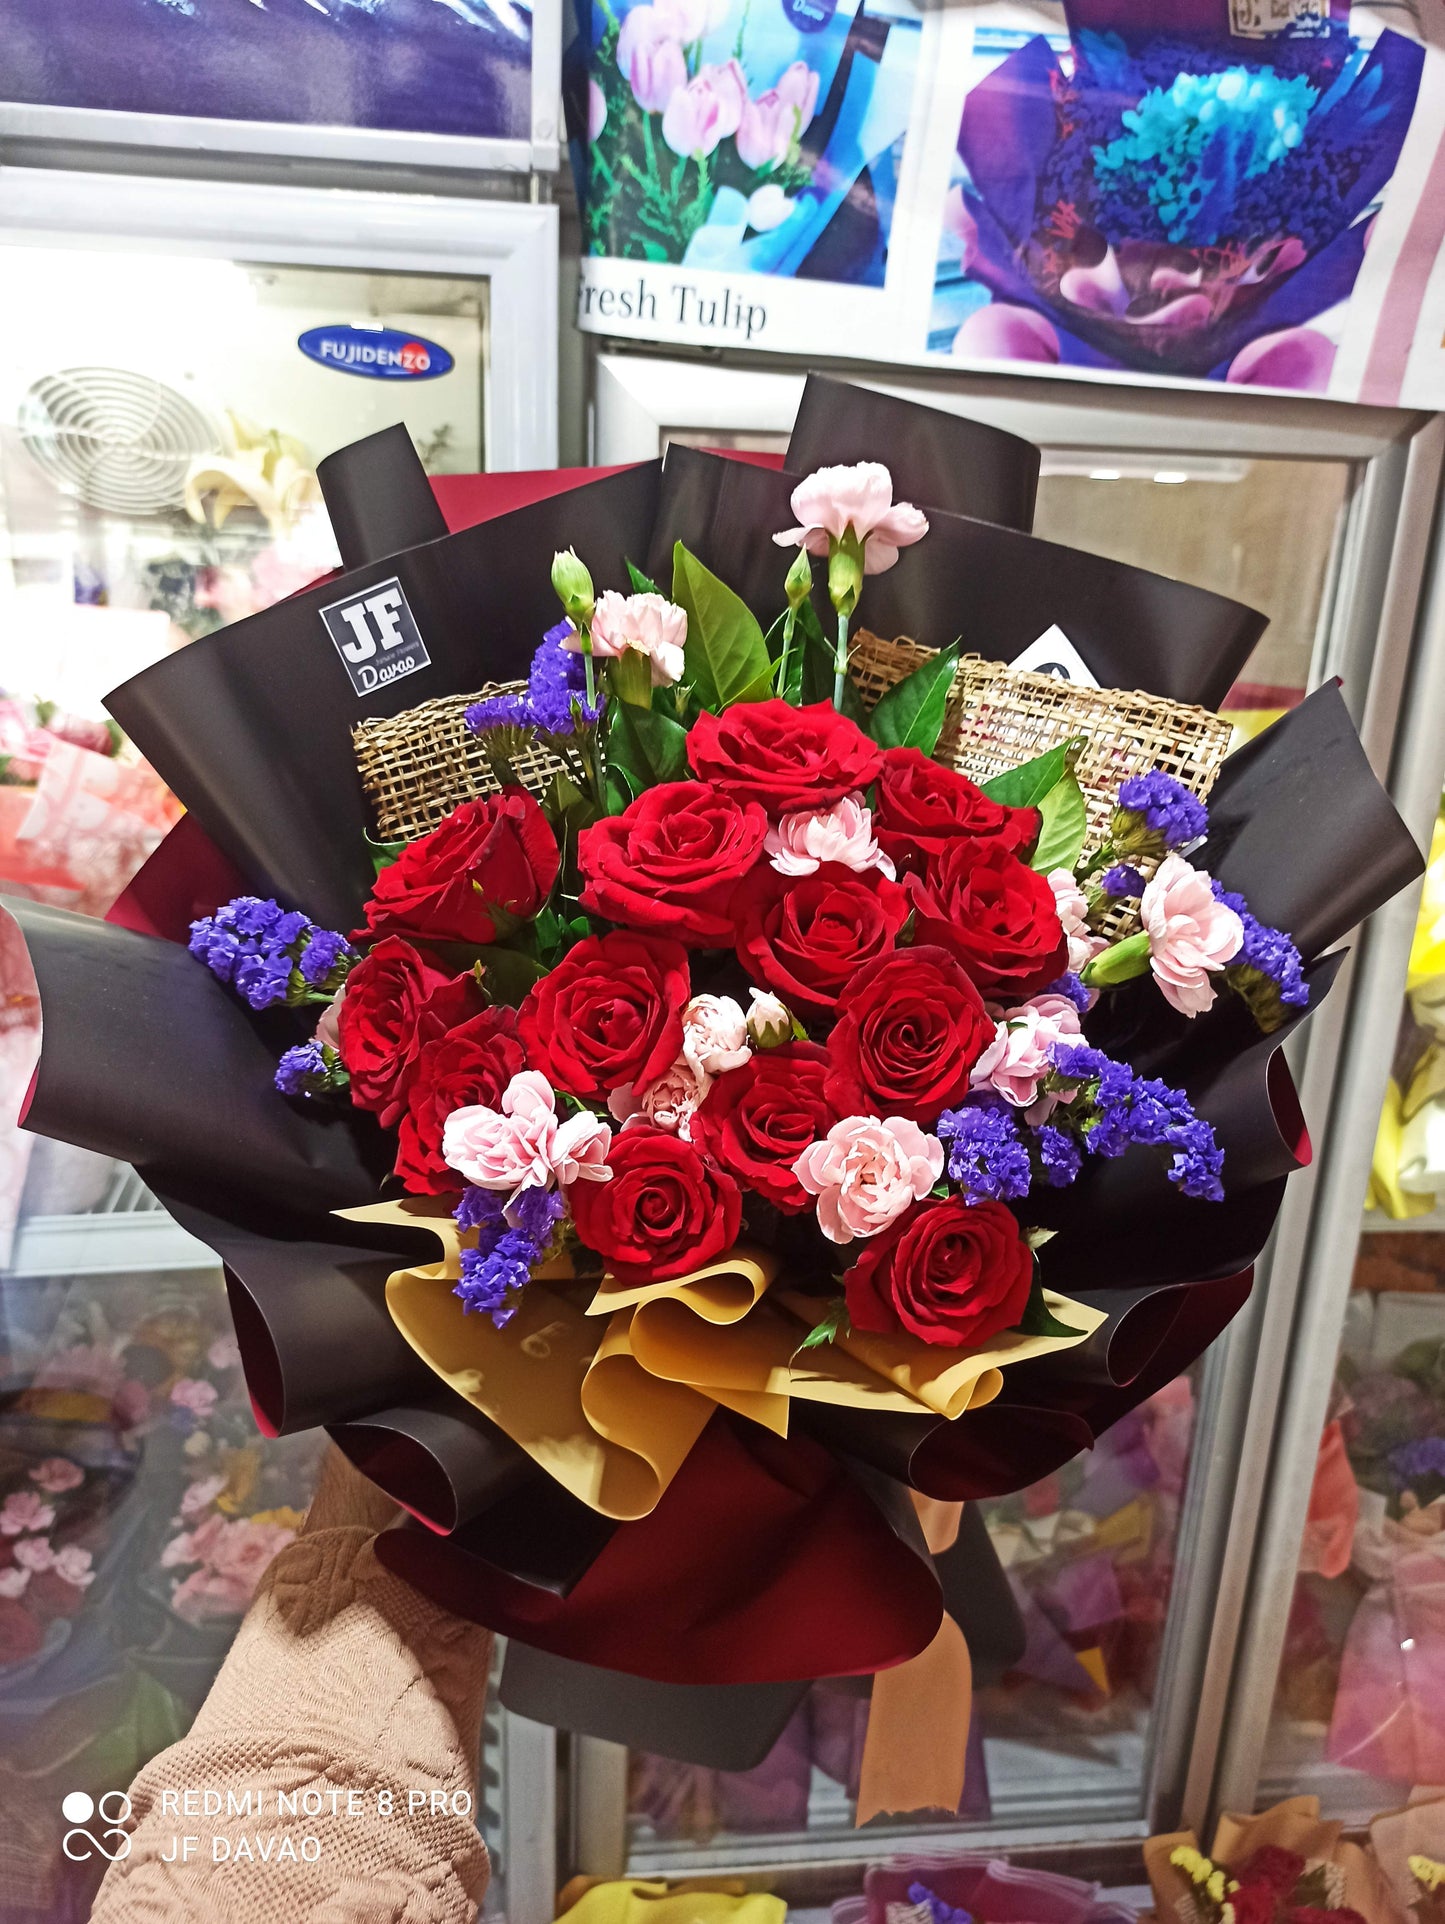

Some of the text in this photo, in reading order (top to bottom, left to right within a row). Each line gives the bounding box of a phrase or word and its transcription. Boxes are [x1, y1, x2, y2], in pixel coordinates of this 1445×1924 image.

[671, 285, 767, 340] Tulip
[320, 340, 431, 371] FUJIDENZO
[340, 587, 403, 664] JF
[357, 655, 415, 689] Davao
